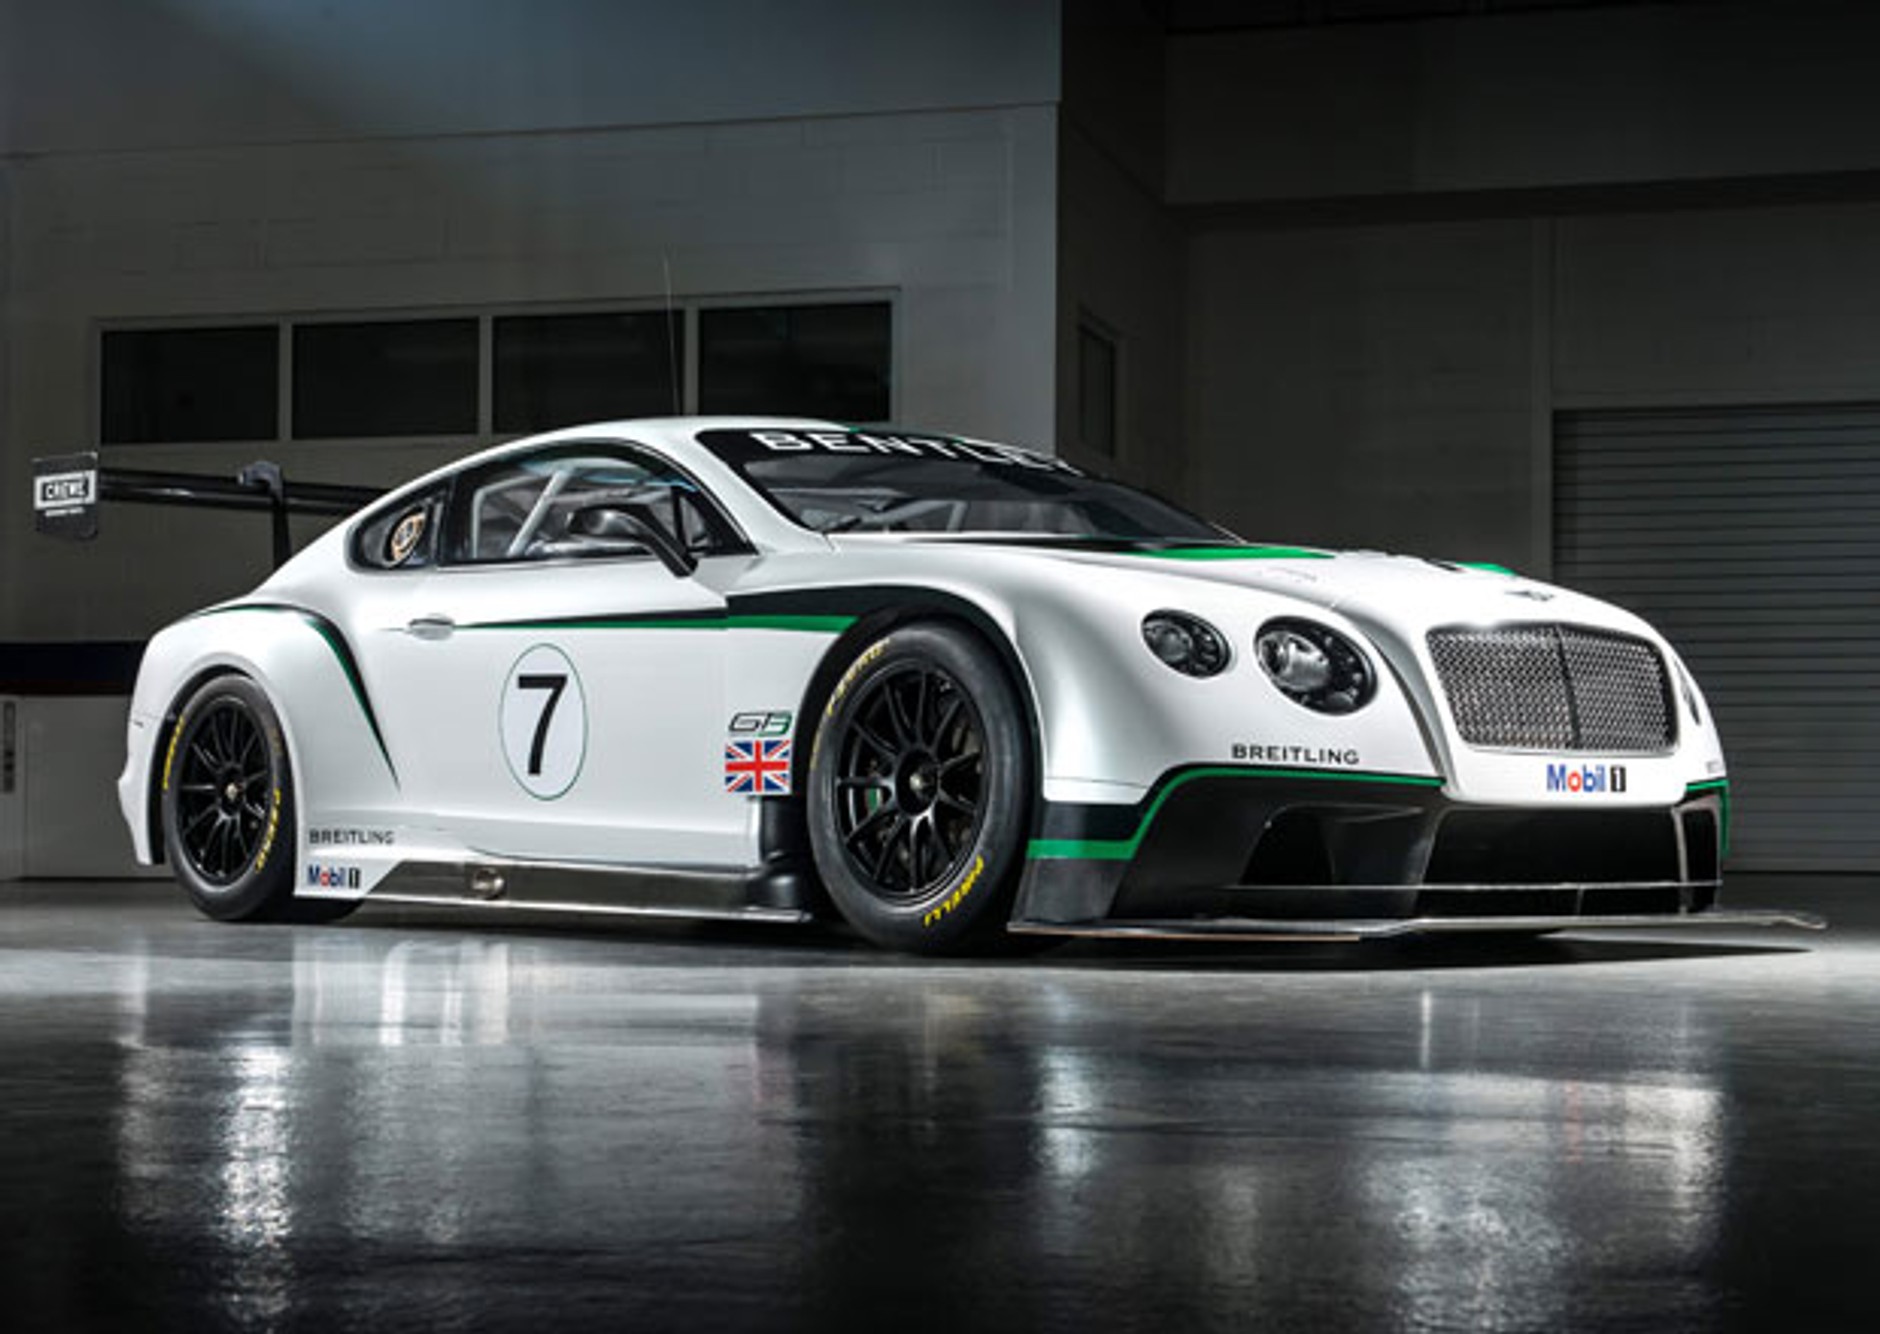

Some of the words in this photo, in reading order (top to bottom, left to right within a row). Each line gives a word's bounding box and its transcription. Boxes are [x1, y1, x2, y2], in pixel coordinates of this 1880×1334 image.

[518, 674, 567, 775] 7
[1231, 743, 1360, 765] BREITLING
[1546, 763, 1606, 793] Mobil
[1610, 765, 1627, 793] 1
[308, 830, 394, 844] BREITLING
[308, 865, 346, 887] Mobil
